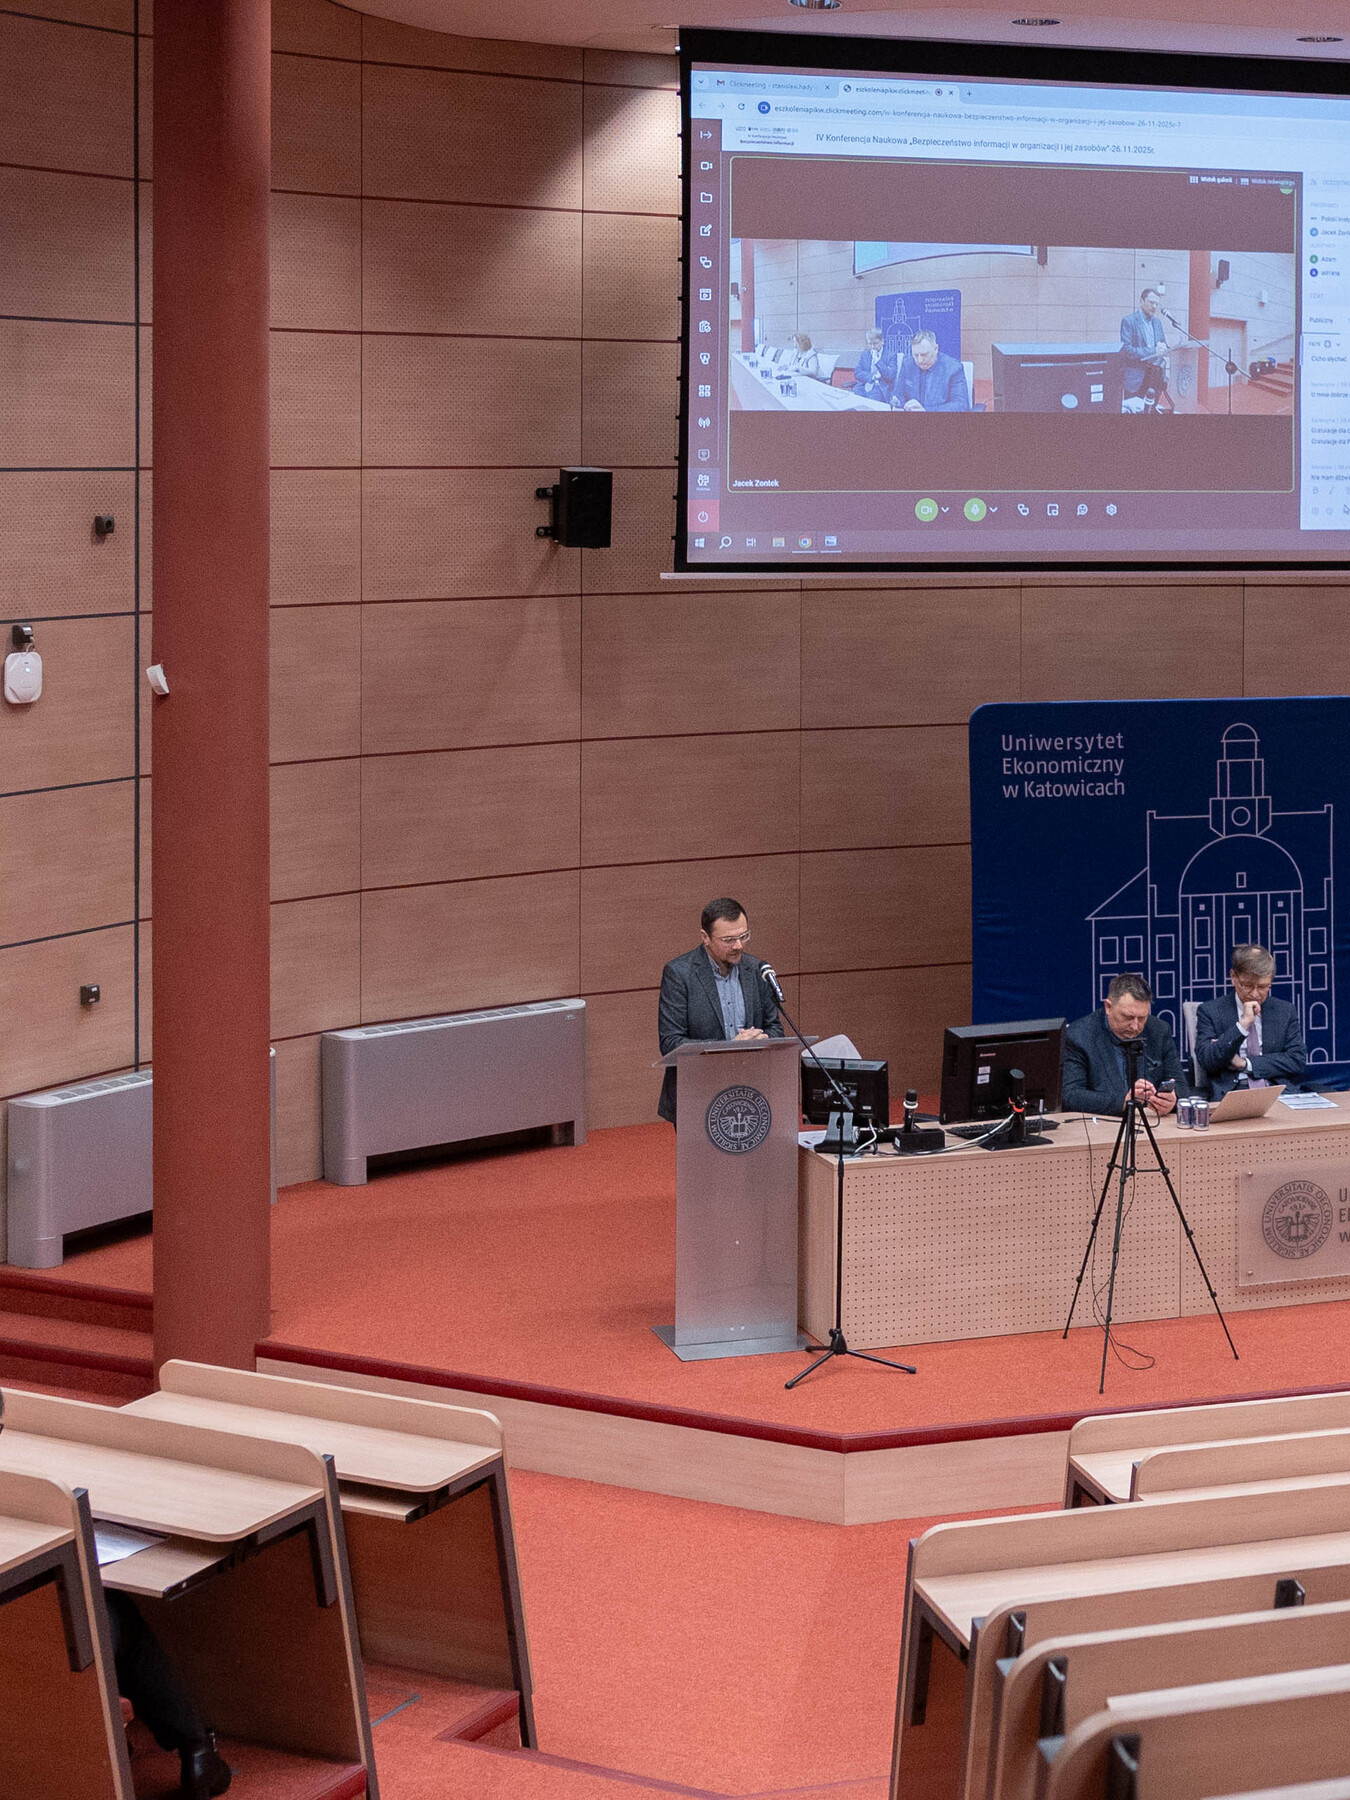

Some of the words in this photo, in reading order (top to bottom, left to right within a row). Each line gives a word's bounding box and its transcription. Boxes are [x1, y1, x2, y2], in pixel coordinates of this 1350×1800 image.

[816, 133, 825, 142] IV
[826, 134, 871, 146] Konferencja
[872, 136, 908, 146] Naukowa
[732, 479, 753, 487] Jacek
[1001, 732, 1124, 754] Uniwersytet
[1002, 756, 1124, 776] Ekonomiczny
[1002, 784, 1019, 798] w
[1024, 778, 1125, 798] Katowicach
[711, 1090, 754, 1122] UNIVERSITATIS
[1264, 1183, 1315, 1223] UNIVERSITATIS
[1339, 1230, 1350, 1243] w
